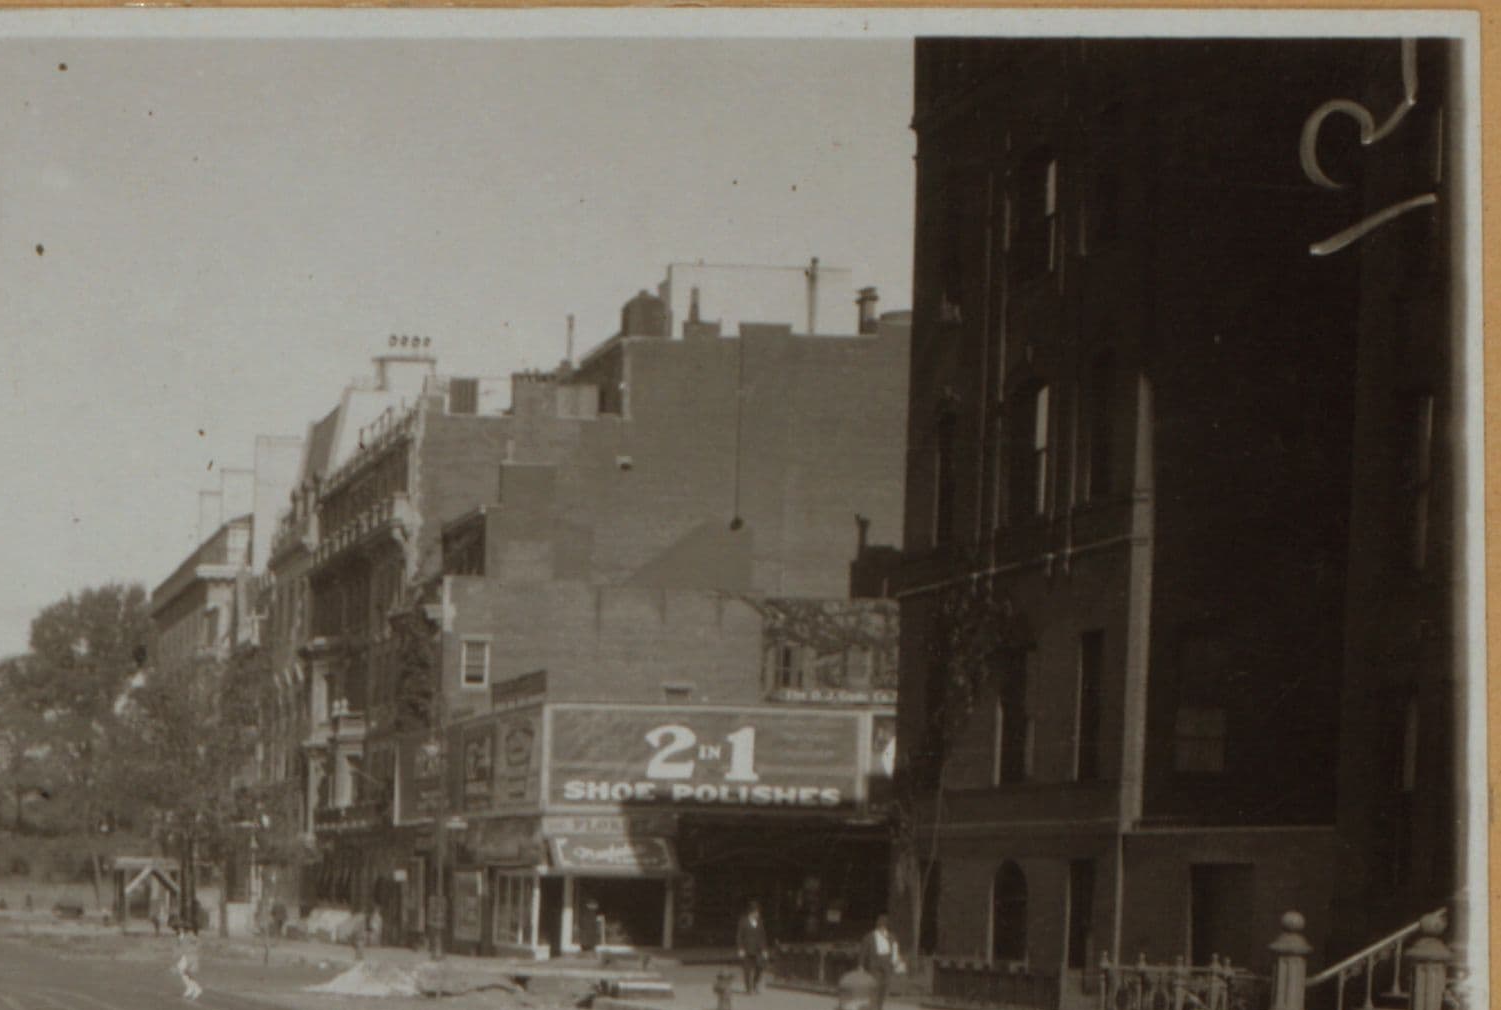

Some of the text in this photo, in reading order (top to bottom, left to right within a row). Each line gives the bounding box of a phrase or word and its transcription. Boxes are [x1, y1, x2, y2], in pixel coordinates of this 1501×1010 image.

[645, 724, 696, 778] 2
[699, 744, 722, 760] IN
[724, 726, 760, 782] 1
[563, 780, 842, 806] SHOE POLISHES
